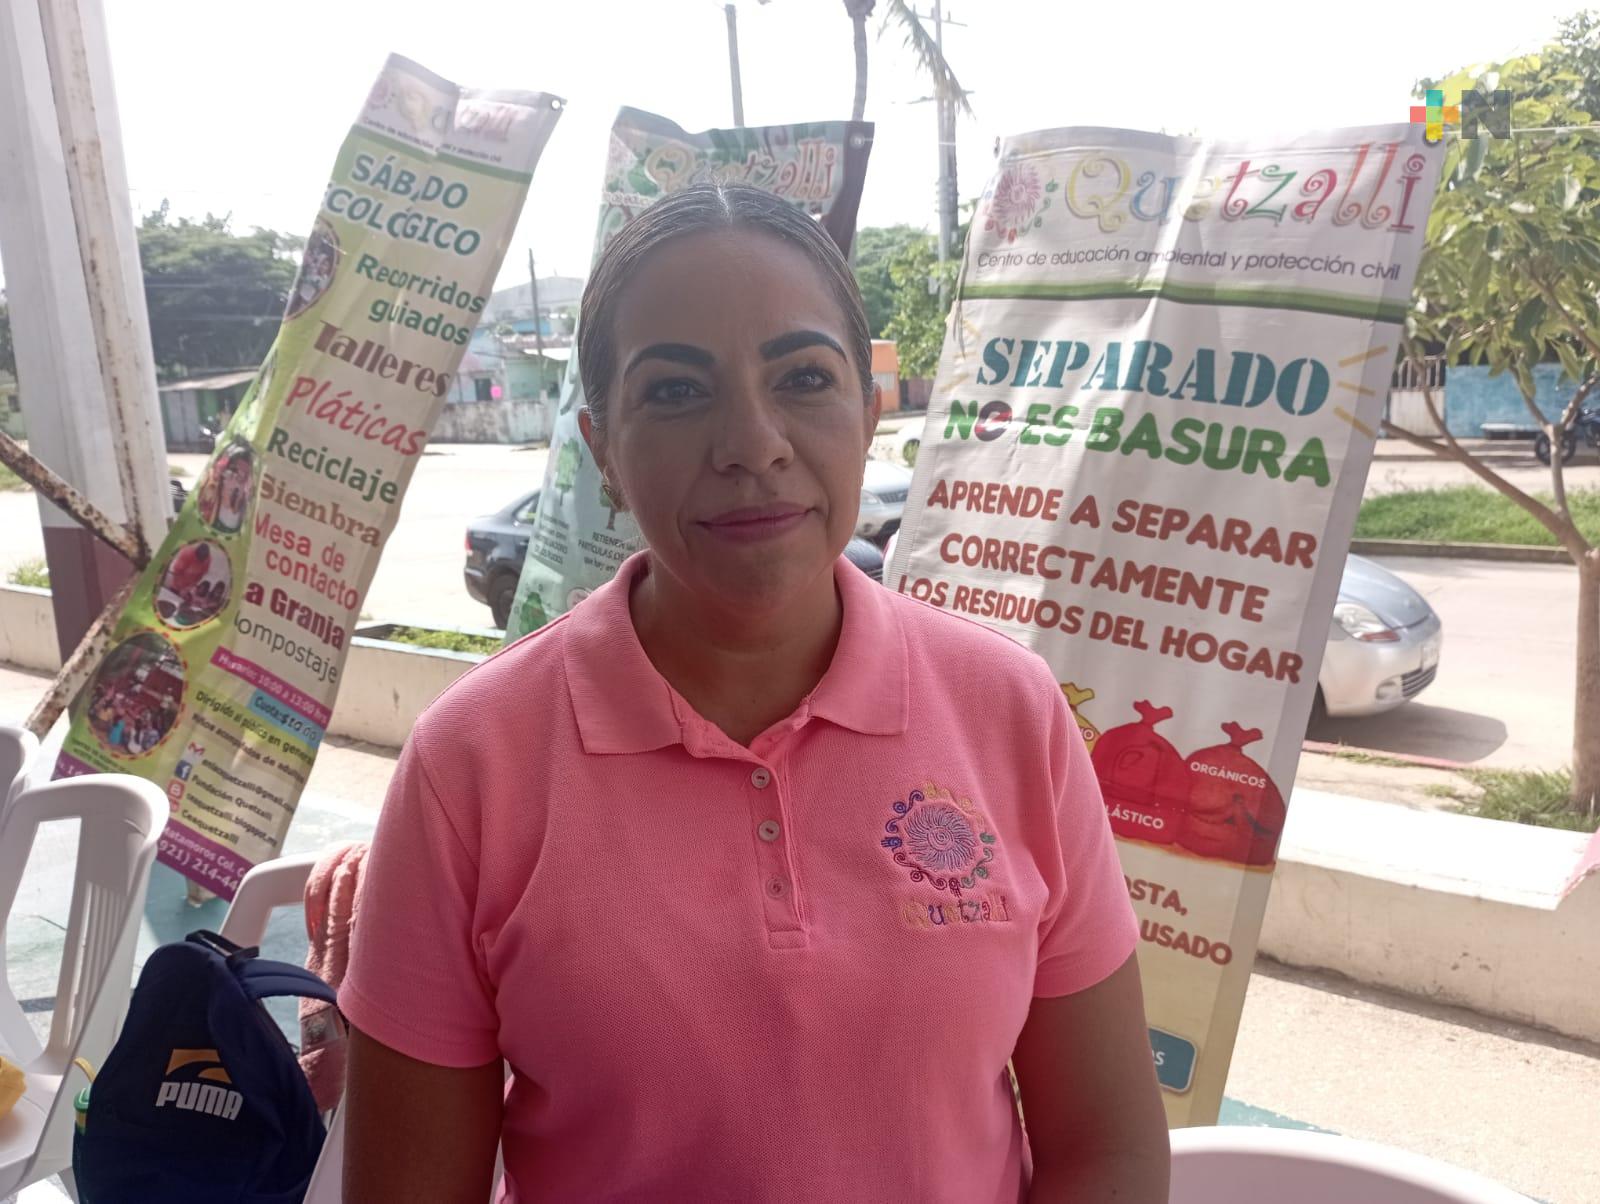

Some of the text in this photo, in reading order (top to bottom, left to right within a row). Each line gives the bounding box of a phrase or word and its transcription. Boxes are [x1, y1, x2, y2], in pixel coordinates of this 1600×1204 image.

[351, 155, 469, 210] SÁBDO
[1064, 141, 1428, 233] Quetzalli
[325, 183, 481, 256] COLÓGICO
[355, 253, 486, 313] Recorridos
[978, 244, 1401, 281] Centro de educación ambiental y protección civil
[368, 298, 470, 346] guiados
[313, 320, 451, 397] Talleres
[976, 336, 1331, 416] SEPARADO
[285, 376, 427, 457] Pláticas
[943, 399, 1332, 488] NO ES BASURA
[267, 427, 399, 504] Reciclaje
[255, 511, 345, 574] Mesa de
[260, 473, 381, 548] Siembra
[927, 479, 1318, 569] APRENDE A SEPARAR
[266, 549, 359, 610] contacto
[940, 532, 1270, 623] CORRECTAMENTE
[269, 587, 345, 650] Granja
[898, 574, 1304, 684] LOS RESIDUOS DEL HOGAR
[1190, 761, 1267, 789] ORGÁNICOS
[1104, 803, 1164, 830] LÁSTICO
[1140, 919, 1233, 966] USADO
[155, 1081, 244, 1121] PUMA
